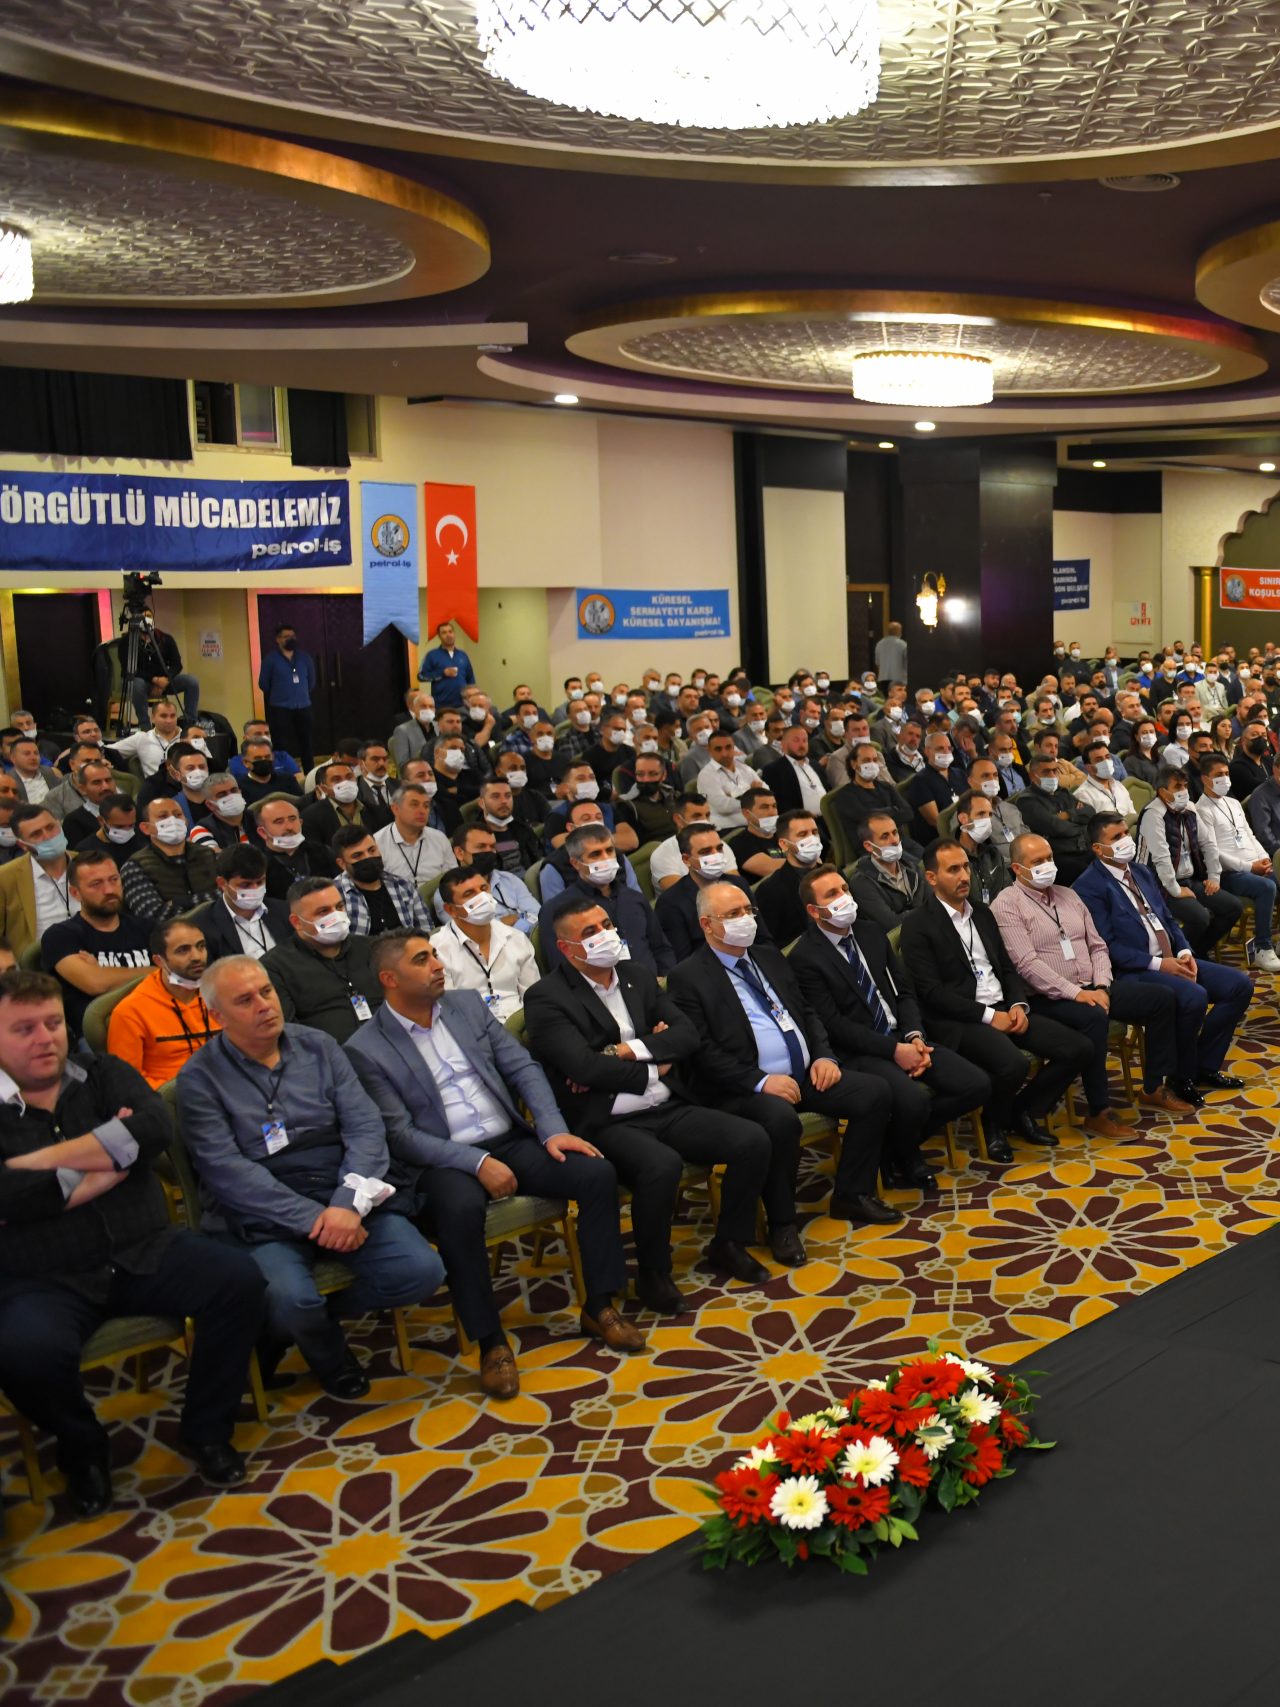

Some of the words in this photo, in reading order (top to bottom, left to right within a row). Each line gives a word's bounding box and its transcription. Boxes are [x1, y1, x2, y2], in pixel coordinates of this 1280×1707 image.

[0, 484, 146, 526] ÖRGÜTLÜ
[154, 491, 341, 528] MÜCADELEMİZ
[252, 538, 342, 559] petrol-iş
[652, 593, 692, 604] KÜRESEL
[630, 606, 685, 616] SERMAYEYE
[686, 606, 713, 617] KARŞI
[622, 616, 665, 627] KÜRESEL
[667, 617, 721, 628] DAYANIŞMA!
